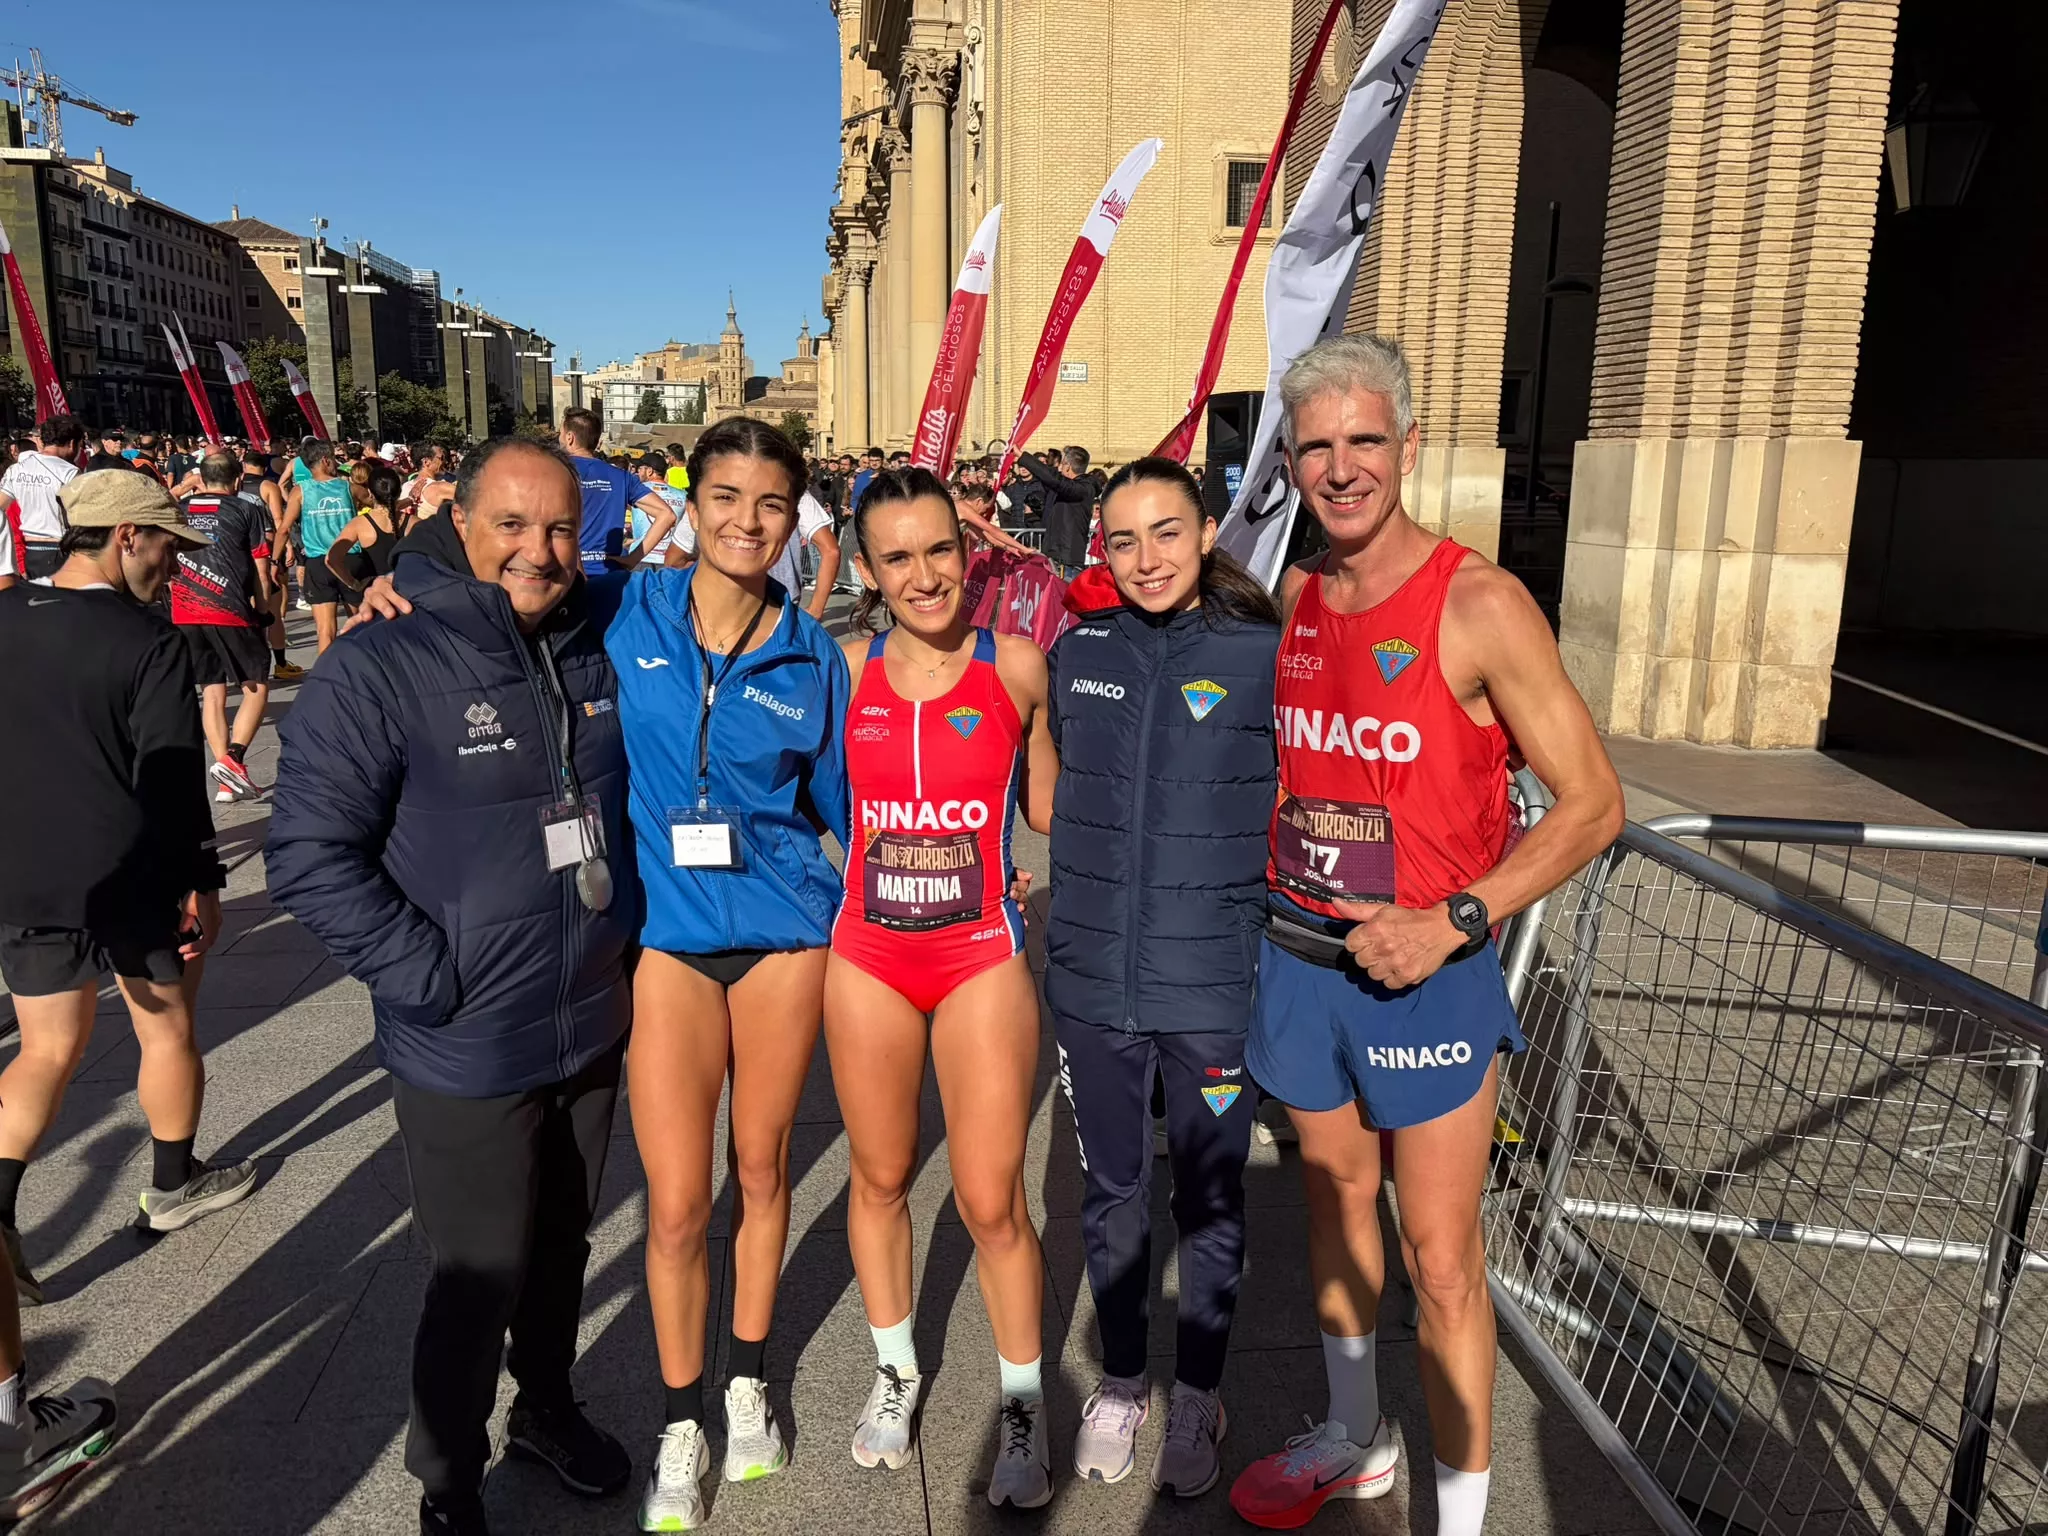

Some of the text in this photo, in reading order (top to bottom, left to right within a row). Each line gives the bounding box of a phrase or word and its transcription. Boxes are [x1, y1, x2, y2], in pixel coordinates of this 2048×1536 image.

[932, 306, 957, 389] ALIMENTOS
[942, 304, 965, 393] DELICIOSOS
[1225, 467, 1241, 477] 2000
[188, 517, 219, 527] uesca
[176, 552, 229, 588] Gran Trail
[1070, 678, 1126, 701] HINACO
[861, 705, 892, 718] 42K
[852, 726, 890, 737] Huesca
[1273, 704, 1422, 763] HINACO
[861, 799, 989, 831] HINACO
[1307, 811, 1385, 842] ZARAGOZA
[906, 842, 975, 871] ZARAGOZA
[1300, 838, 1341, 876] 77
[877, 872, 962, 903] MARTINA
[910, 906, 922, 915] 14
[970, 925, 1006, 941] 42K
[1367, 1040, 1472, 1069] HINACO
